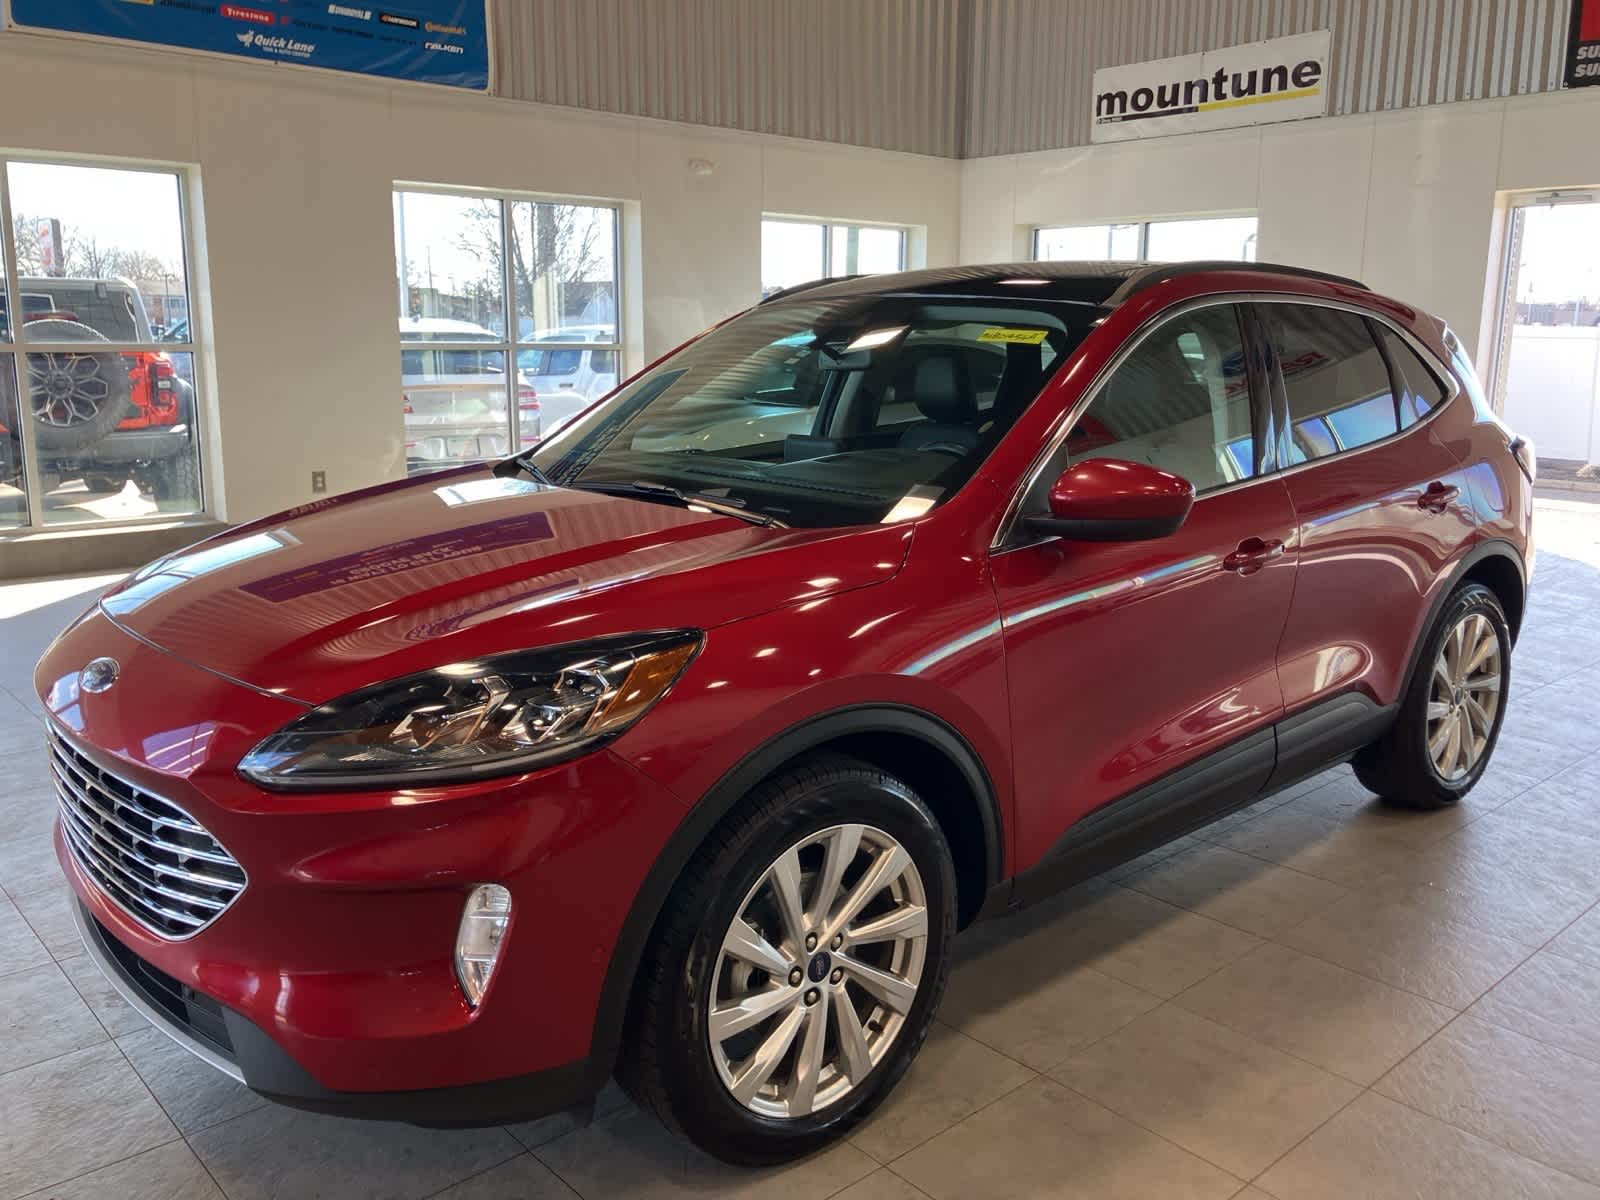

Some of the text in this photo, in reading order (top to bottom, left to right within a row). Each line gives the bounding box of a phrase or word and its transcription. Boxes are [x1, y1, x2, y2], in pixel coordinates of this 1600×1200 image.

[254, 34, 287, 48] Quick
[287, 39, 315, 53] Lane
[1577, 45, 1600, 60] SU
[1096, 59, 1322, 117] mountune
